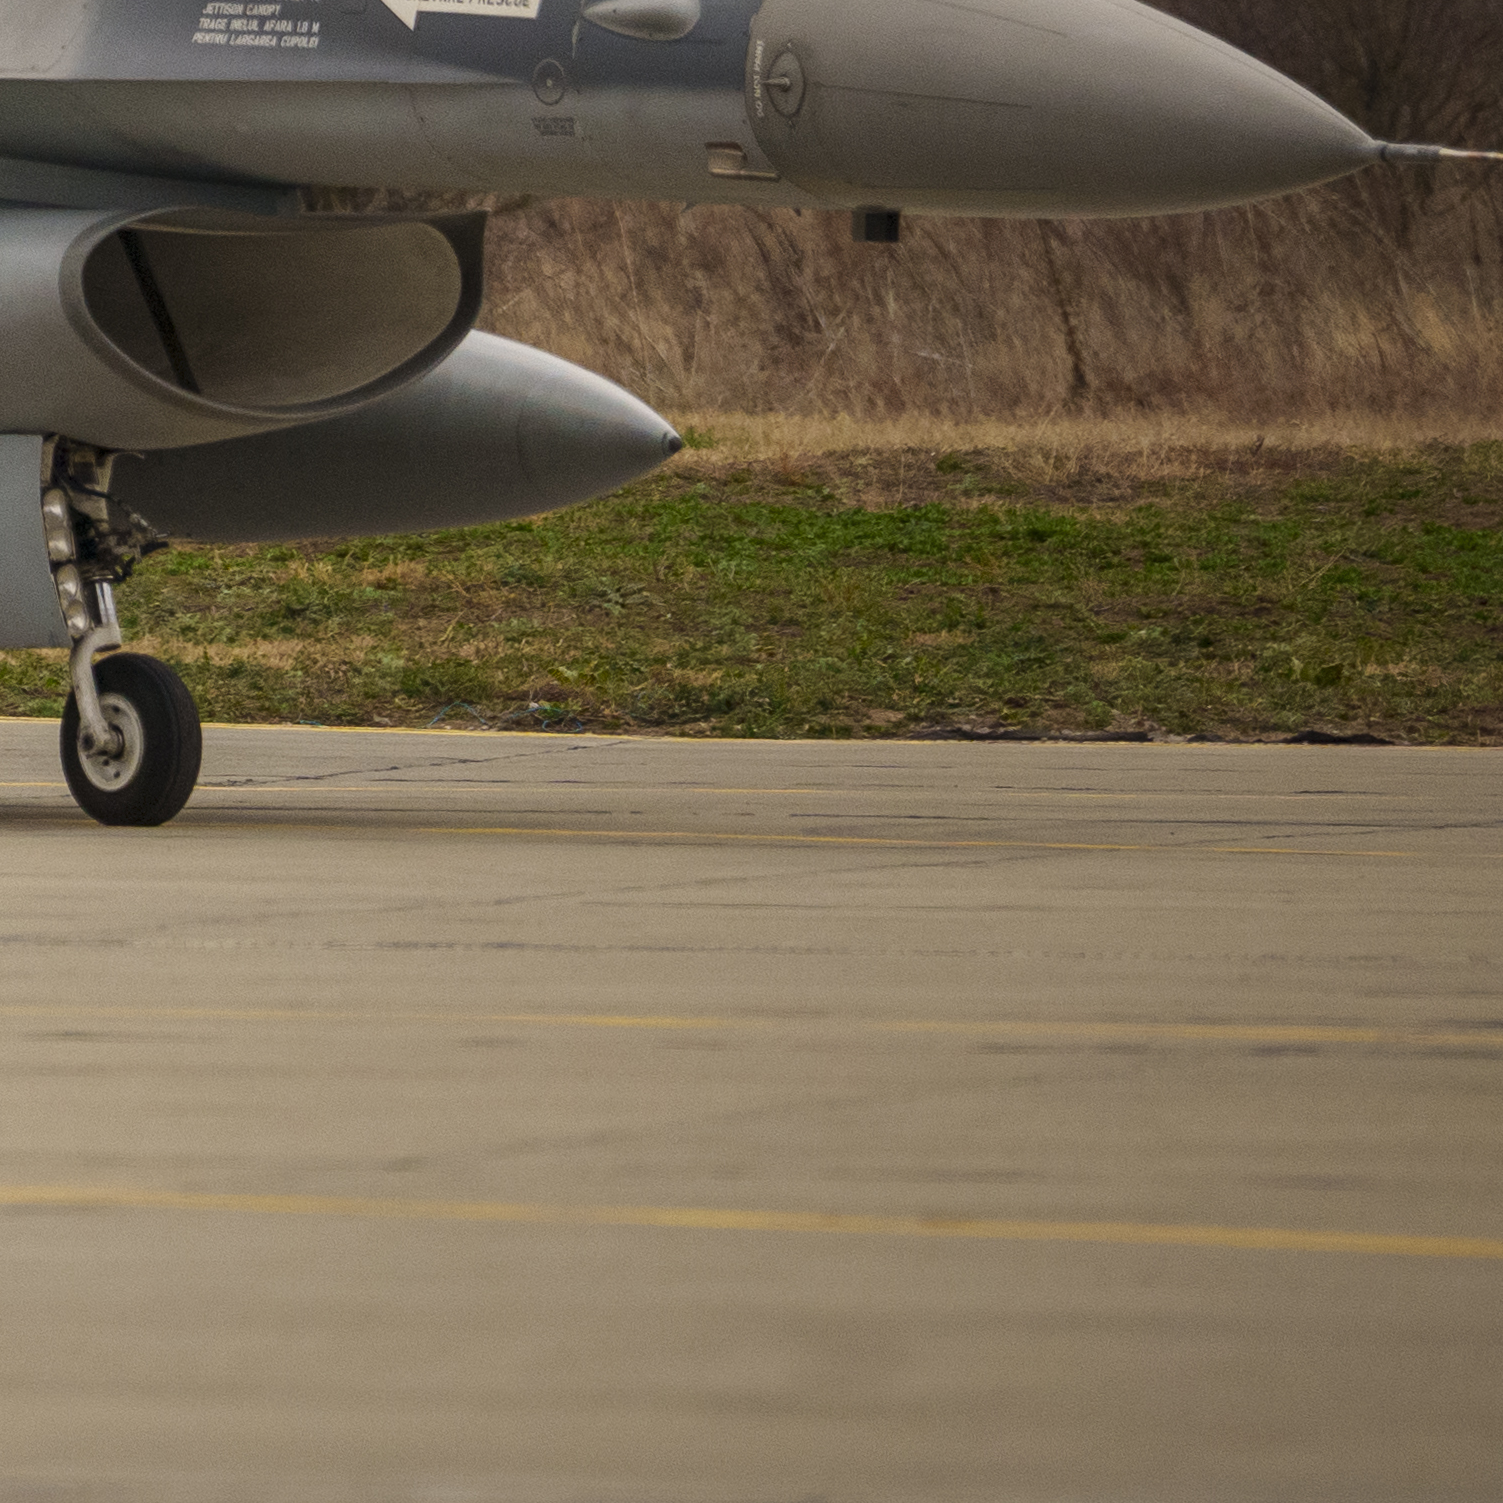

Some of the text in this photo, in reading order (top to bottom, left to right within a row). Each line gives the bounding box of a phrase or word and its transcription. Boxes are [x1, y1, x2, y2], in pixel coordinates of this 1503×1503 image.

[202, 2, 282, 15] JETTISON CANOPY
[199, 17, 228, 30] TRAGE
[263, 20, 292, 32] AFARA
[311, 21, 320, 33] M
[192, 32, 229, 44] PENTRU
